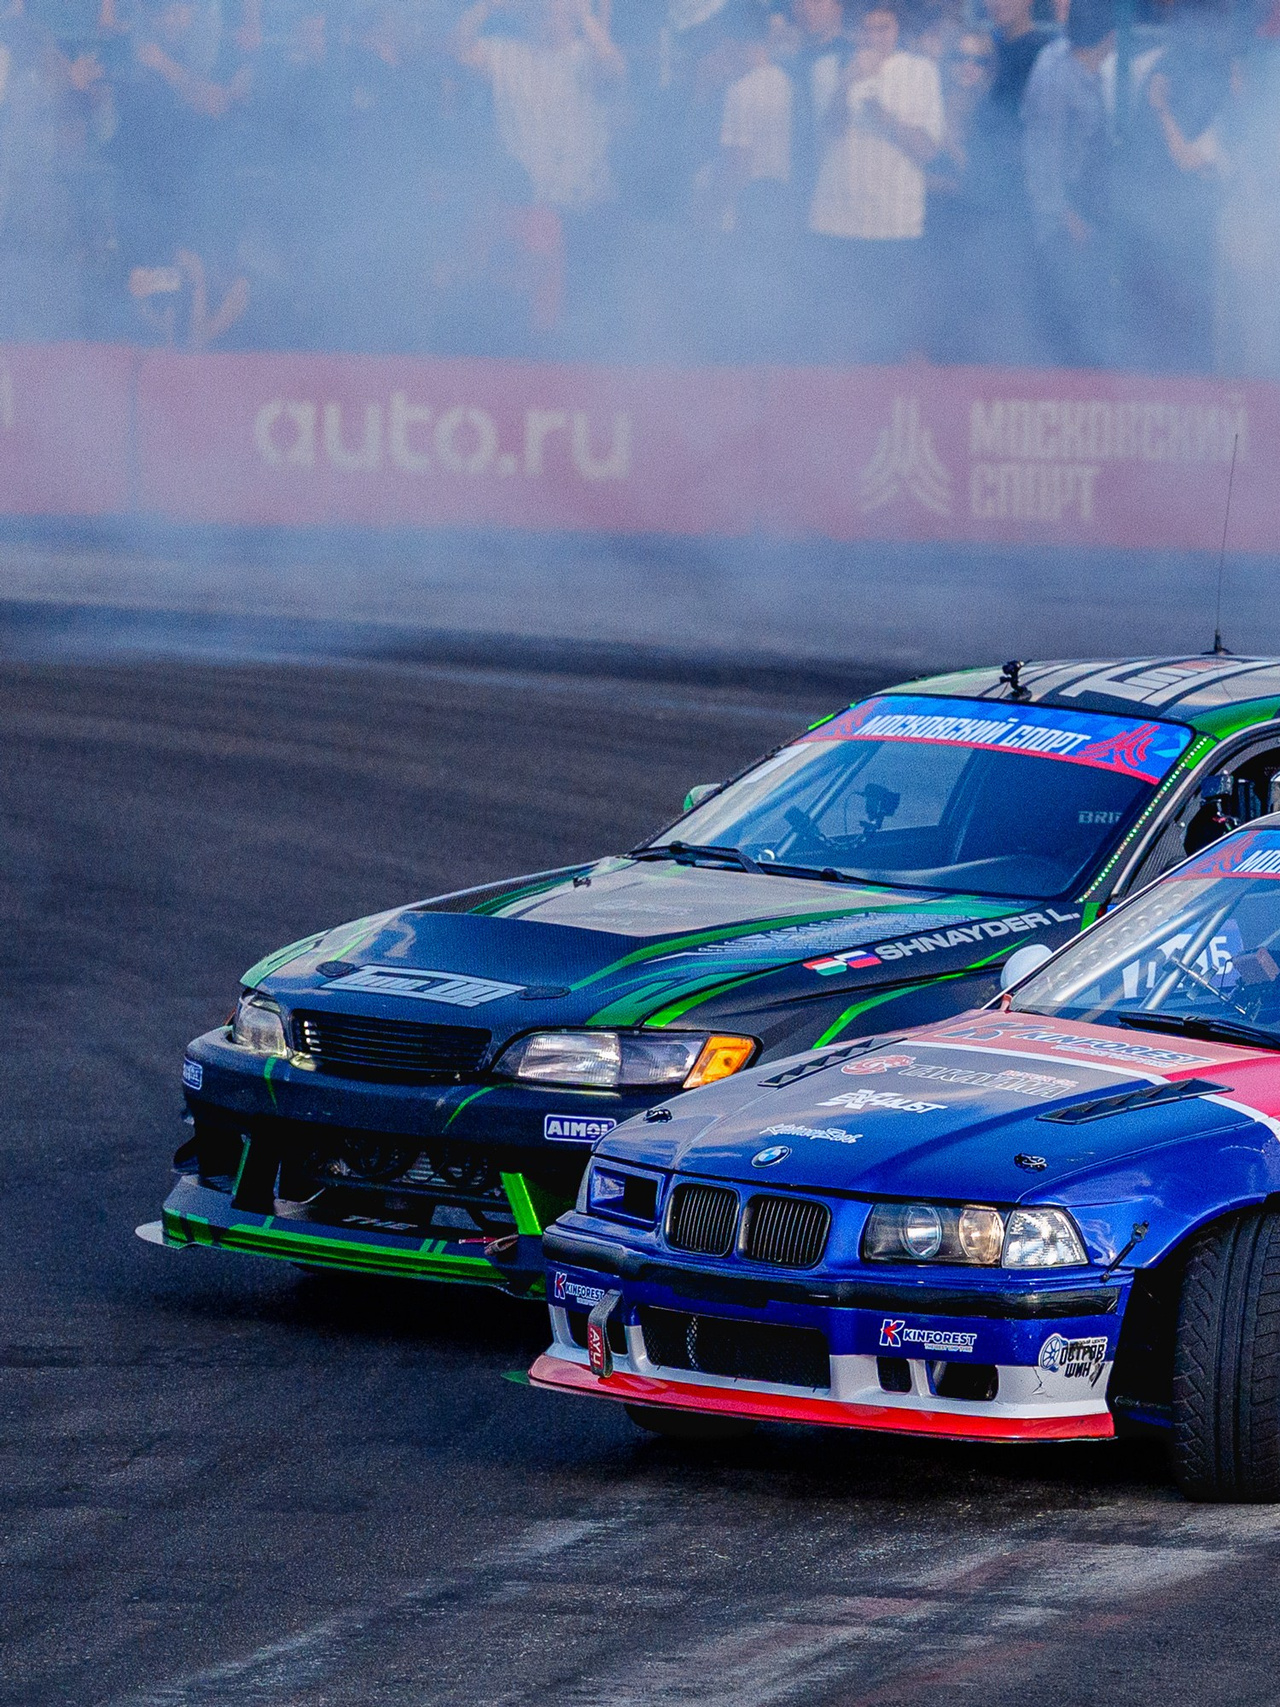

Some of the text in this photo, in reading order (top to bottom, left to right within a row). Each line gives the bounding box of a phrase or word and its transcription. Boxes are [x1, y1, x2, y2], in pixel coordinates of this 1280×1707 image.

[253, 392, 632, 480] auto.ru
[970, 392, 1248, 463] МОСКОВСКИЙ
[970, 462, 1098, 520] СПОРТ
[853, 715, 1092, 755] МОСКОВСКИЙ СПОРТ
[874, 908, 1081, 960] SHNAYDER L.
[1011, 1031, 1217, 1064] KINFOREST
[815, 1089, 948, 1113] EXHAUST
[565, 1282, 605, 1301] KINFOREST
[903, 1329, 977, 1346] KINFOREST
[1059, 1344, 1105, 1366] ОСТРОВ
